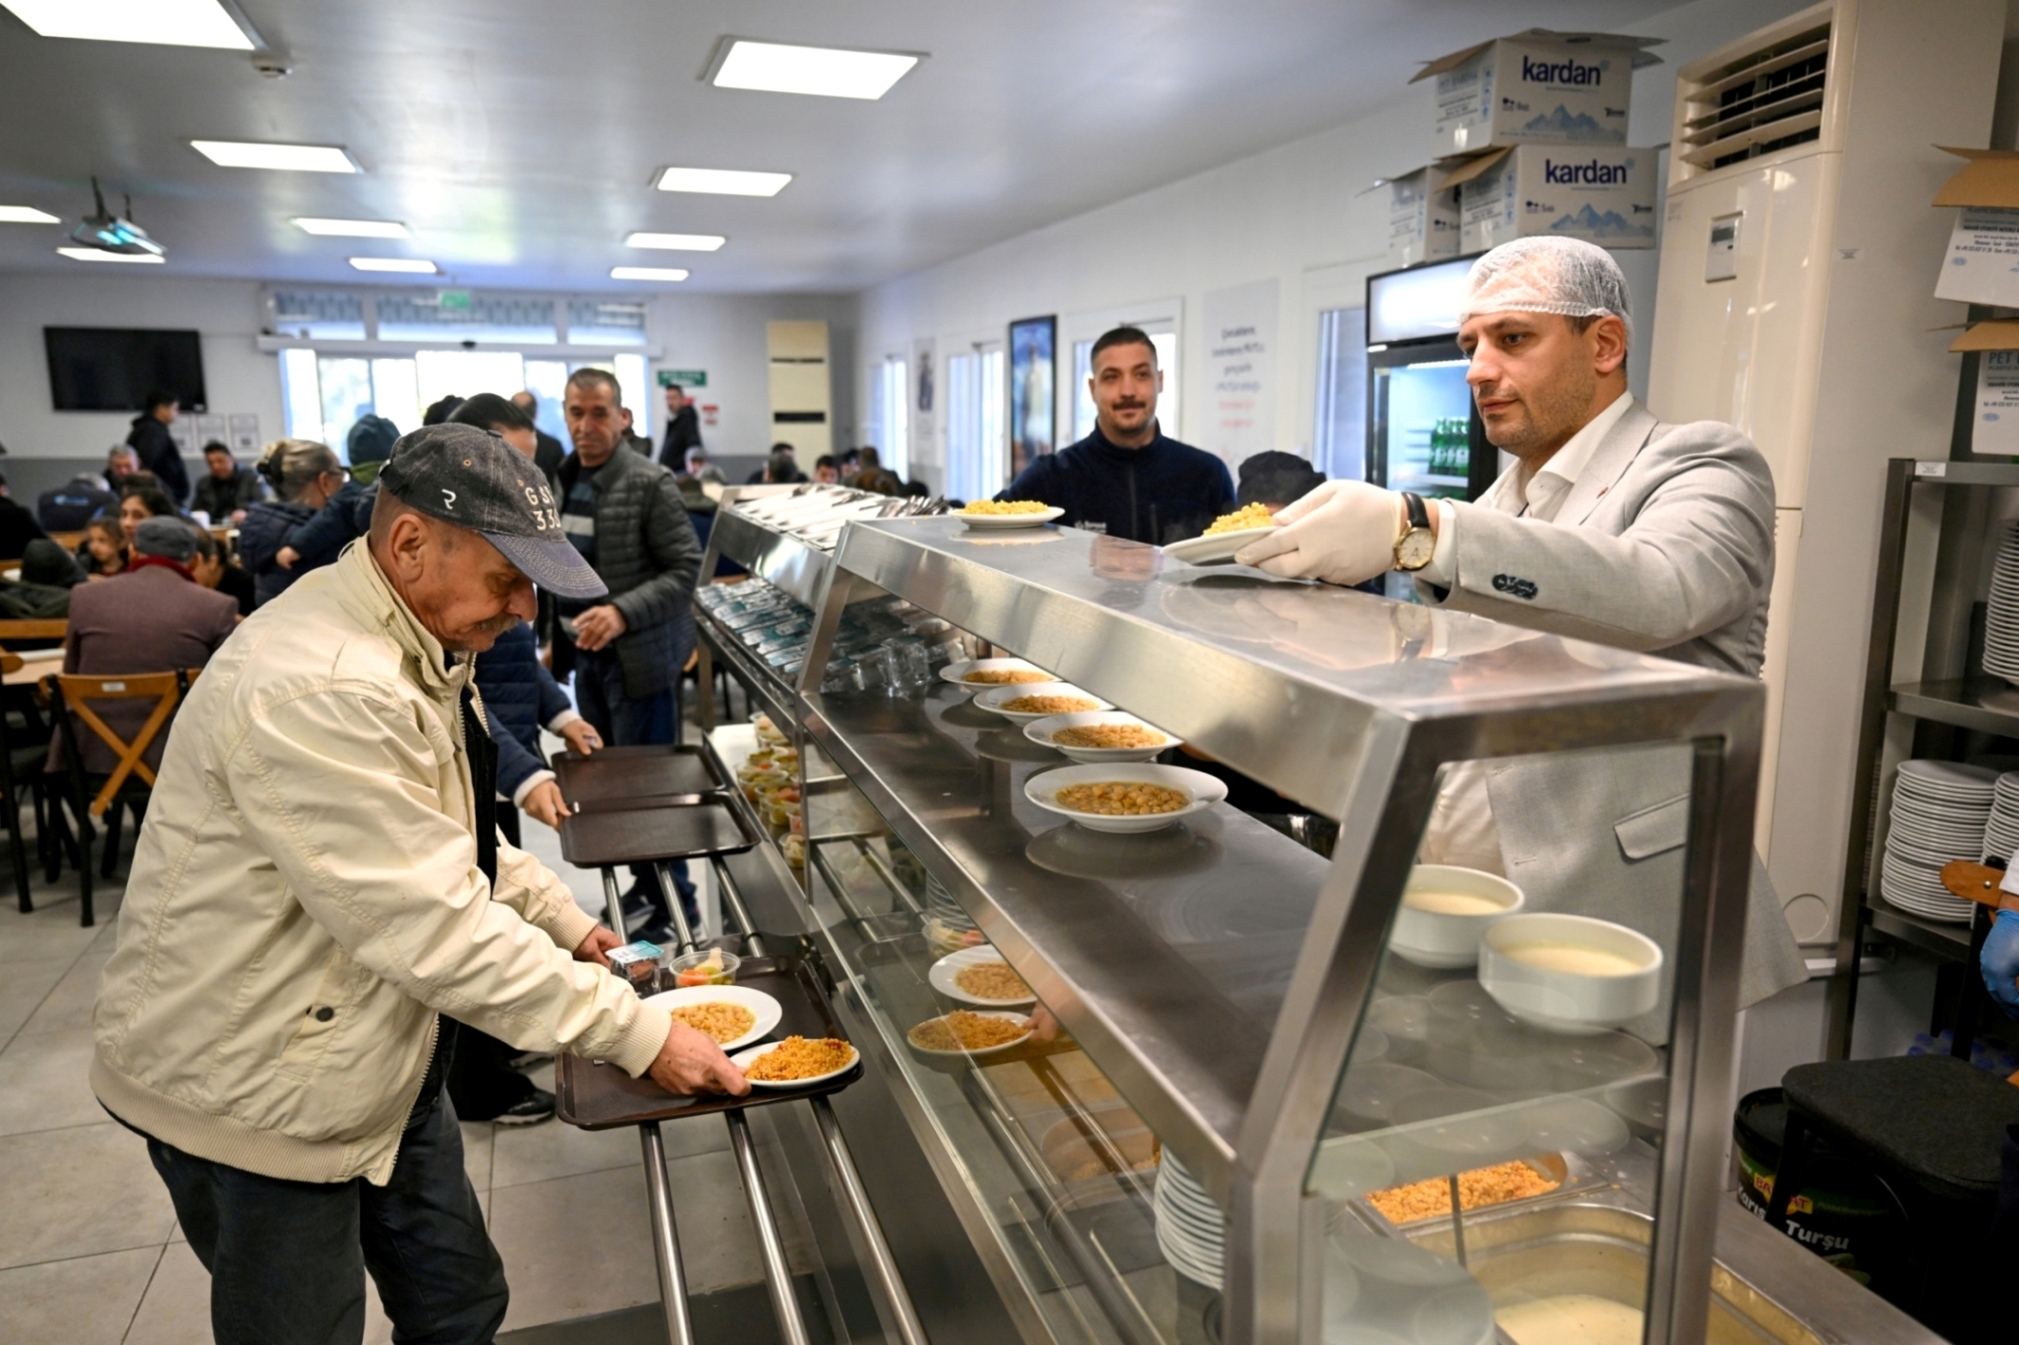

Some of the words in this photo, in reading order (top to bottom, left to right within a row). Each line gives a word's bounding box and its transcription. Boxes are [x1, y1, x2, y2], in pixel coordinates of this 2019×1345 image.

[1522, 56, 1601, 86] kardan
[1545, 159, 1627, 184] kardan
[1785, 1218, 1850, 1252] Turşu
